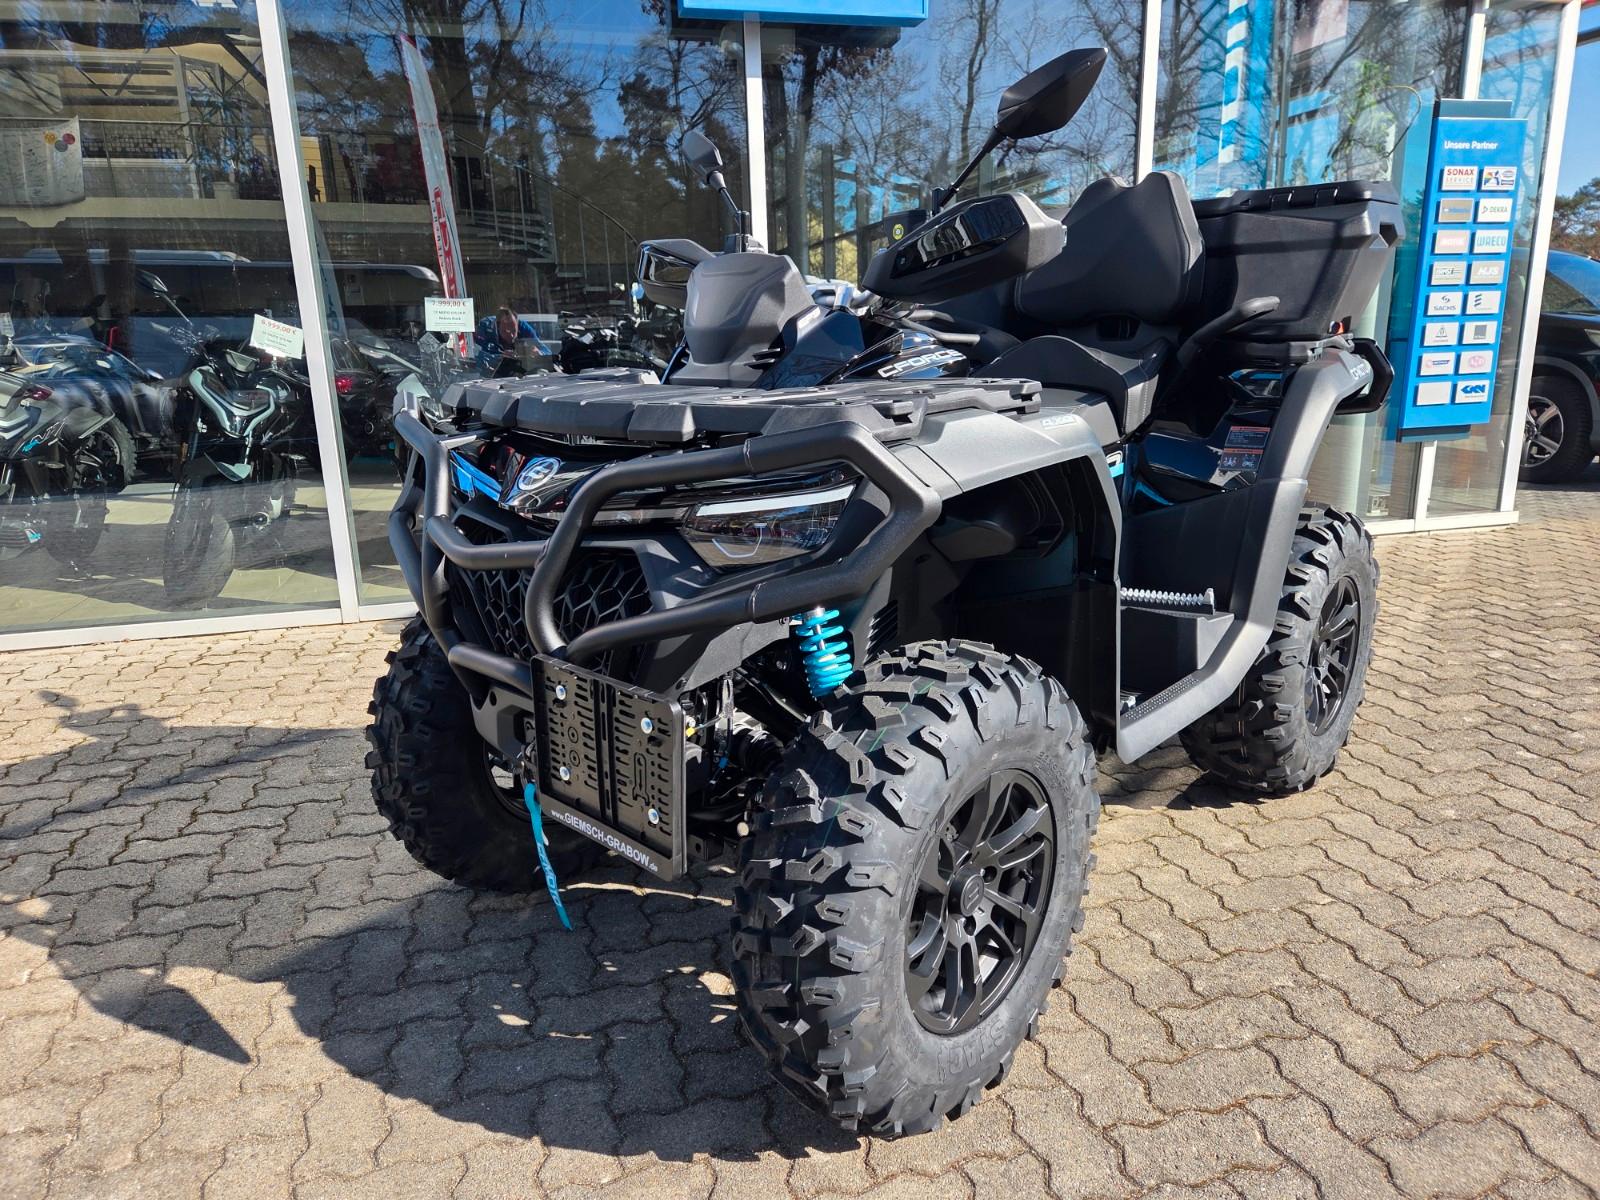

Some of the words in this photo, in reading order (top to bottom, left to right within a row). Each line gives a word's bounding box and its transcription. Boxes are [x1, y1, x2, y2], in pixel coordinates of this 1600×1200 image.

[1443, 140, 1470, 149] Unsere
[1471, 140, 1498, 150] Partner
[1446, 168, 1475, 176] SONAX
[877, 349, 967, 378] CFORCE
[551, 809, 658, 872] www.GIEMSCH-GRABOW.de
